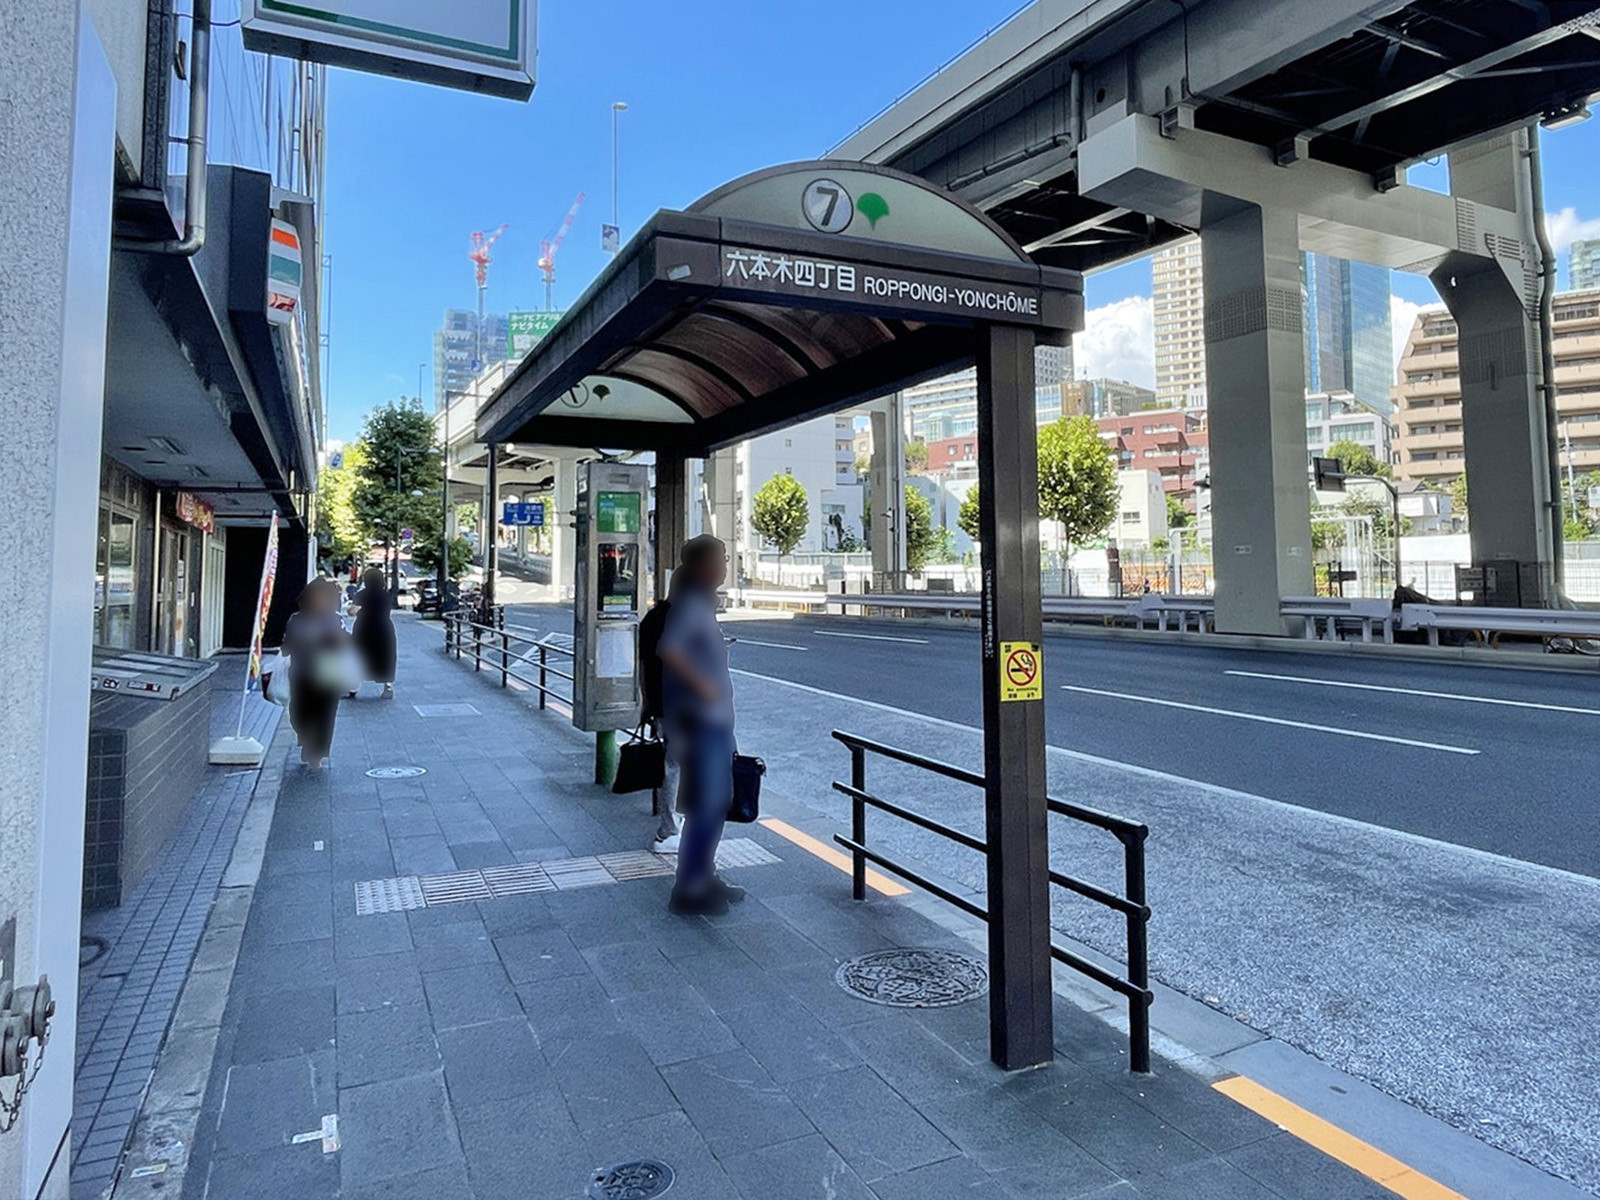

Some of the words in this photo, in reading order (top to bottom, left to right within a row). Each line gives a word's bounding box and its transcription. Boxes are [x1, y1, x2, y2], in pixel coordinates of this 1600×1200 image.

[815, 186, 840, 227] 7
[725, 250, 857, 294] 六本木四丁目
[863, 275, 1039, 317] ROPPONGI-YONCHŌME
